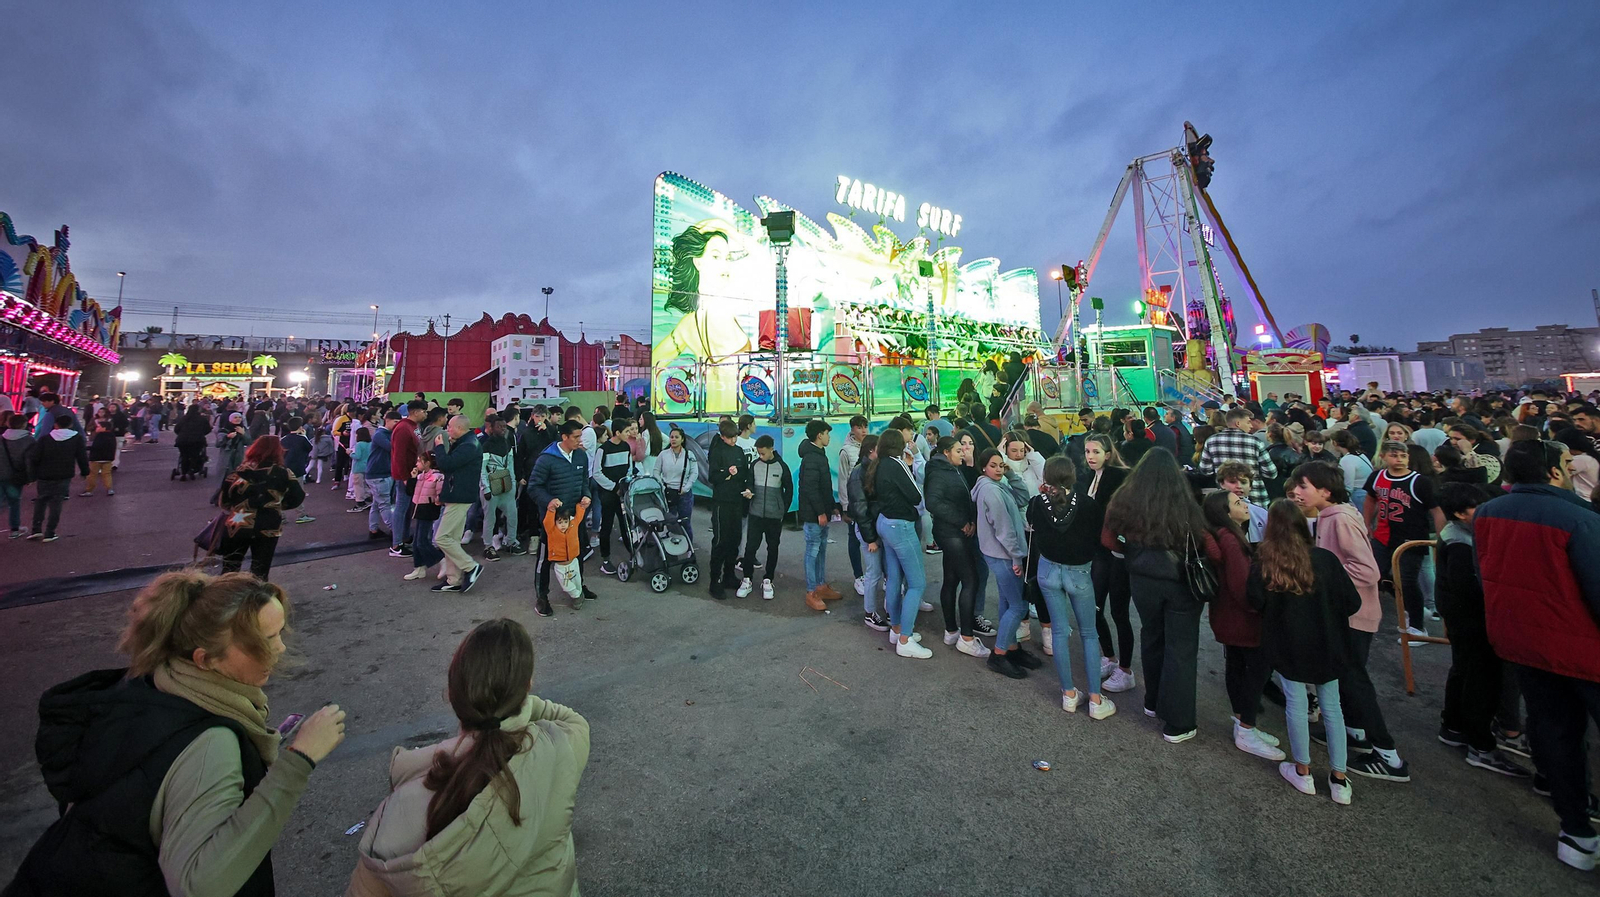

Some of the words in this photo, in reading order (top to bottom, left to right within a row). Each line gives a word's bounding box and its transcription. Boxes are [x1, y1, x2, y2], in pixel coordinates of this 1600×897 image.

[835, 174, 906, 223] TARIFA
[916, 202, 963, 238] SURF
[186, 362, 206, 375] LA
[211, 362, 253, 375] SELVA
